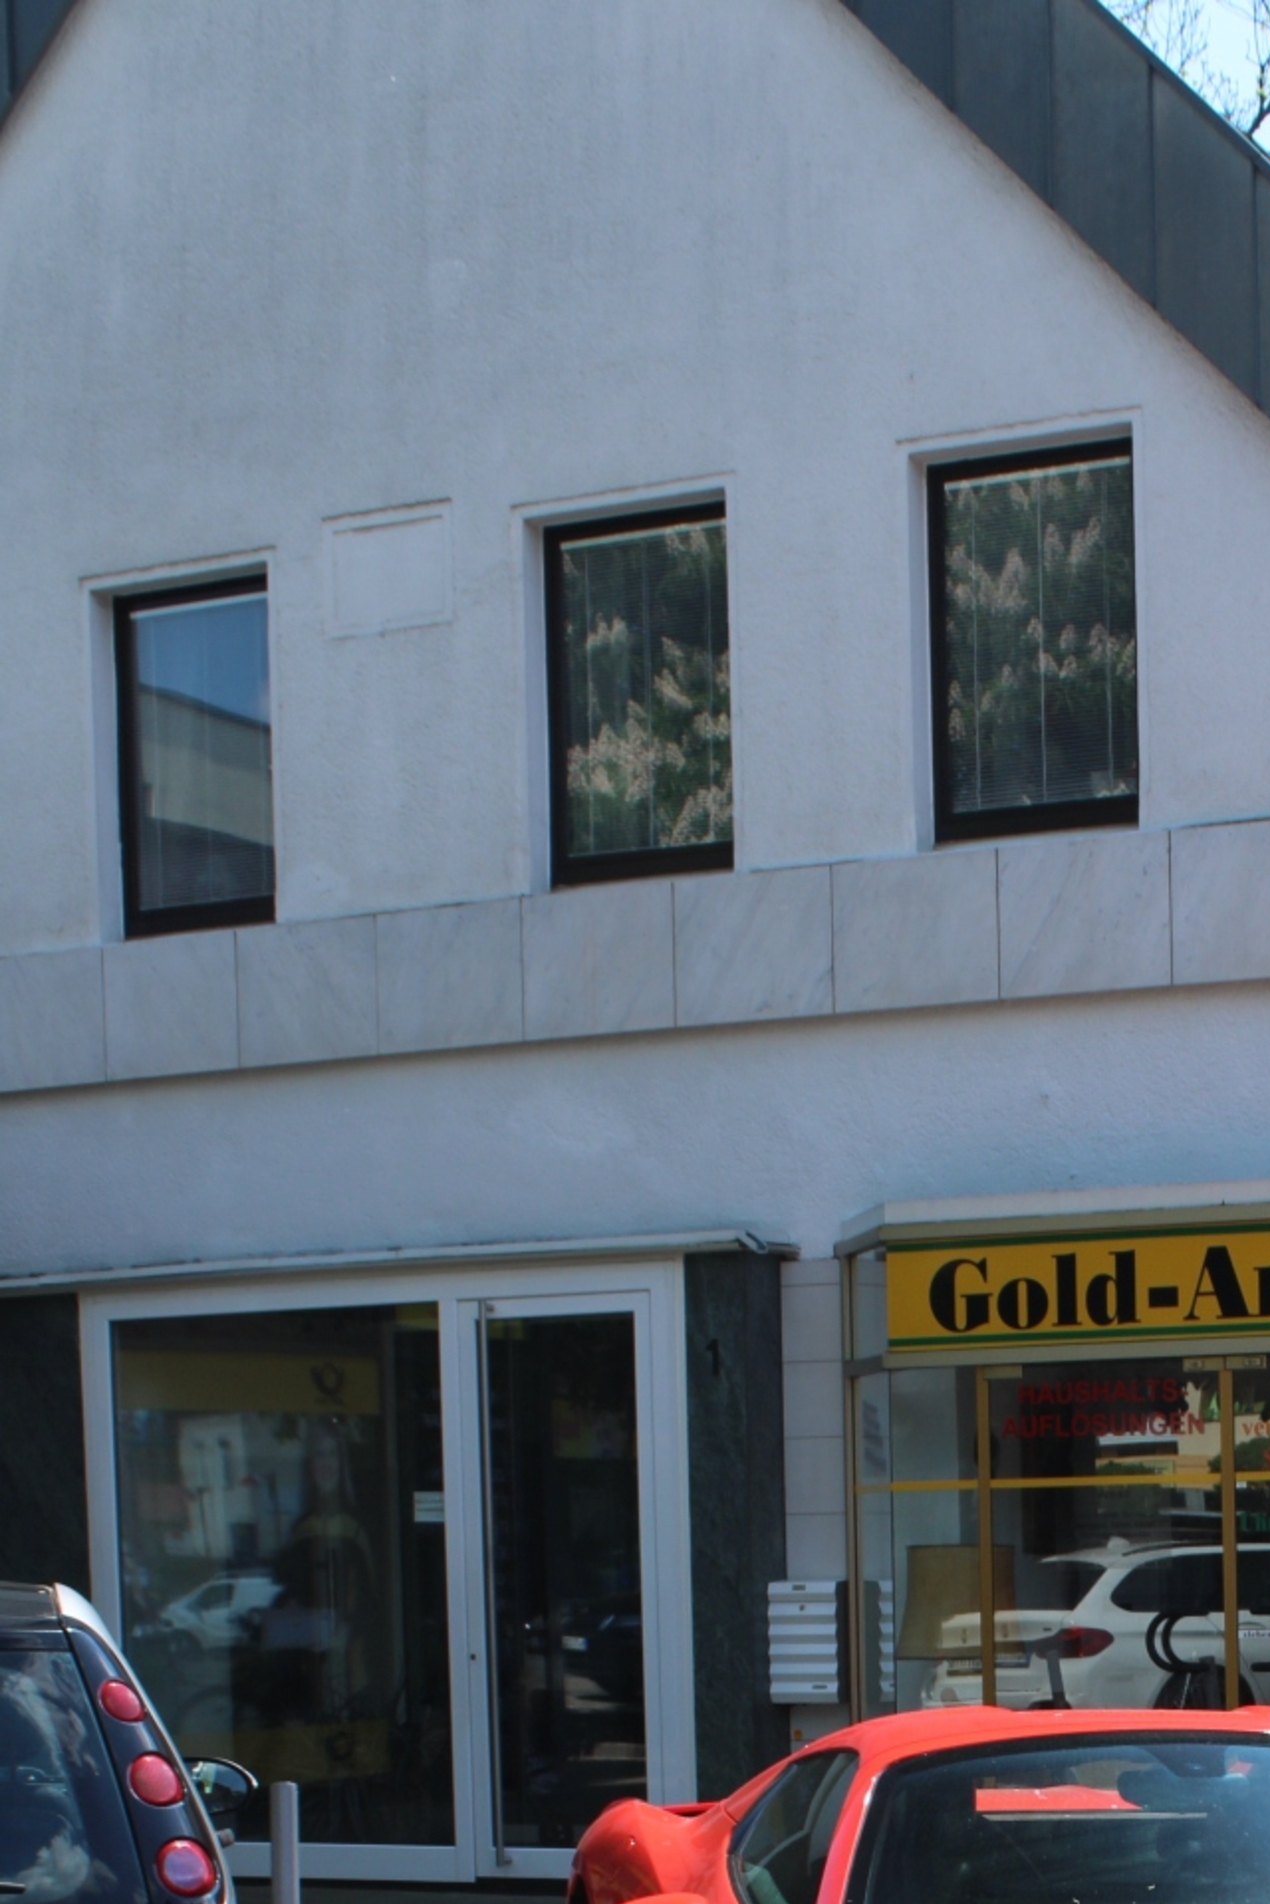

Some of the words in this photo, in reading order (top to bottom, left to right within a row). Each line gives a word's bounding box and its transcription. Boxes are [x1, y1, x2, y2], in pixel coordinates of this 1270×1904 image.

[706, 1338, 719, 1376] 1
[1017, 1376, 1188, 1405] HAUSHALTS-
[1001, 1410, 1205, 1439] AUFLÖSUNGEN
